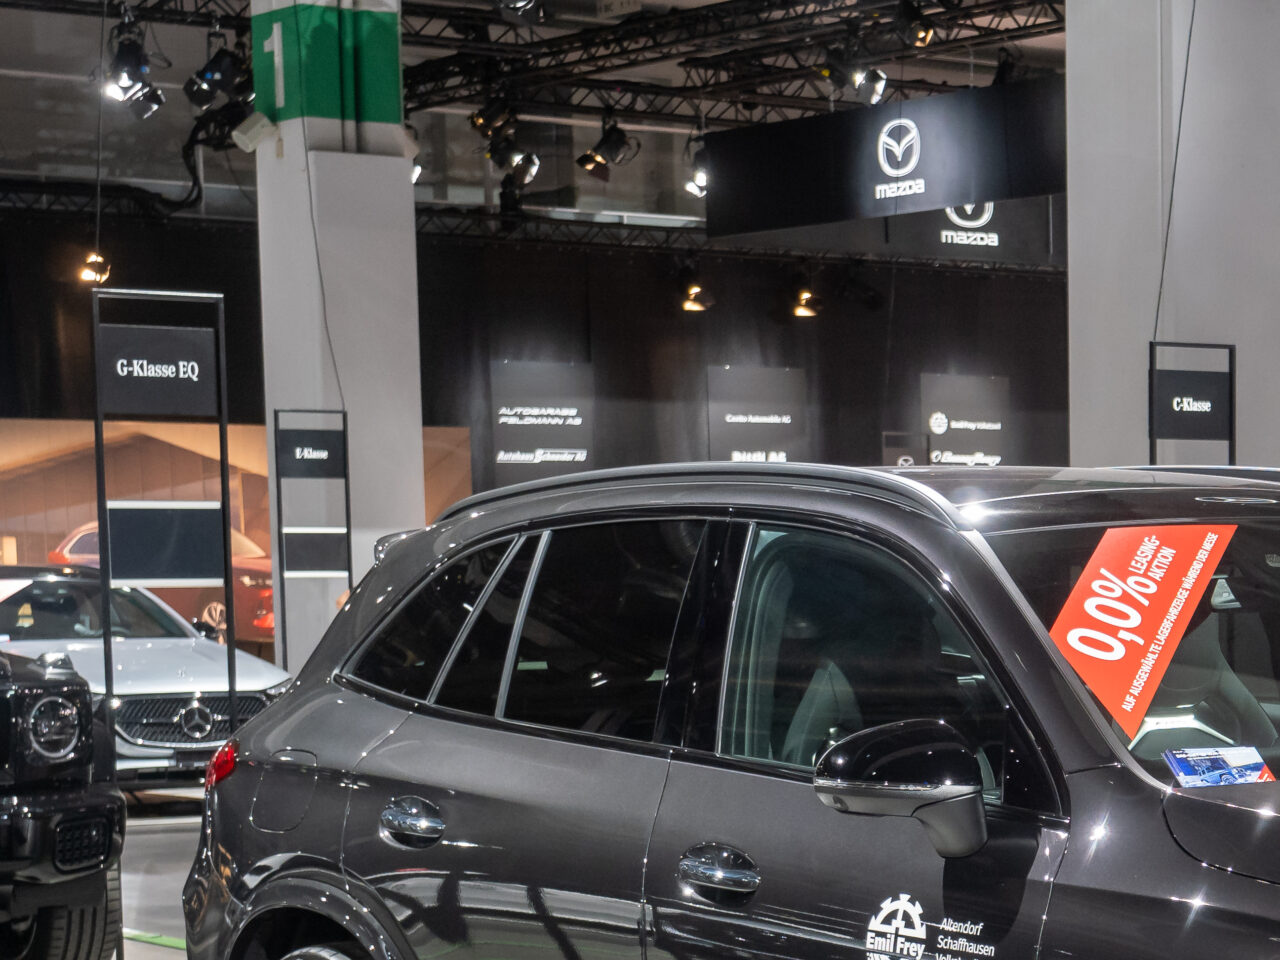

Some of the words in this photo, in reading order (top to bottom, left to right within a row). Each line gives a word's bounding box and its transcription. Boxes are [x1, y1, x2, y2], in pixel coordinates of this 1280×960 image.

[263, 22, 285, 109] 1
[874, 178, 926, 200] mazda
[940, 229, 999, 247] mazda
[116, 358, 177, 378] G-Klasse
[178, 360, 200, 381] EQ
[1172, 396, 1212, 412] C-Klasse
[1201, 532, 1219, 552] MESSE
[1147, 546, 1177, 581] AKTION
[1195, 548, 1210, 563] DER
[1182, 560, 1204, 590] WÄHREND
[1066, 568, 1158, 661] 0,0%
[1128, 535, 1160, 575] LEASING-
[1153, 587, 1190, 646] LAGERFAHRZEUGE
[1128, 643, 1162, 697] AUSGEWÄHLTE
[1121, 694, 1137, 712] AUF
[939, 917, 984, 936] Altendorf
[866, 930, 895, 953] Emil
[896, 936, 926, 960] Frey
[936, 935, 995, 957] Schaffhausen
